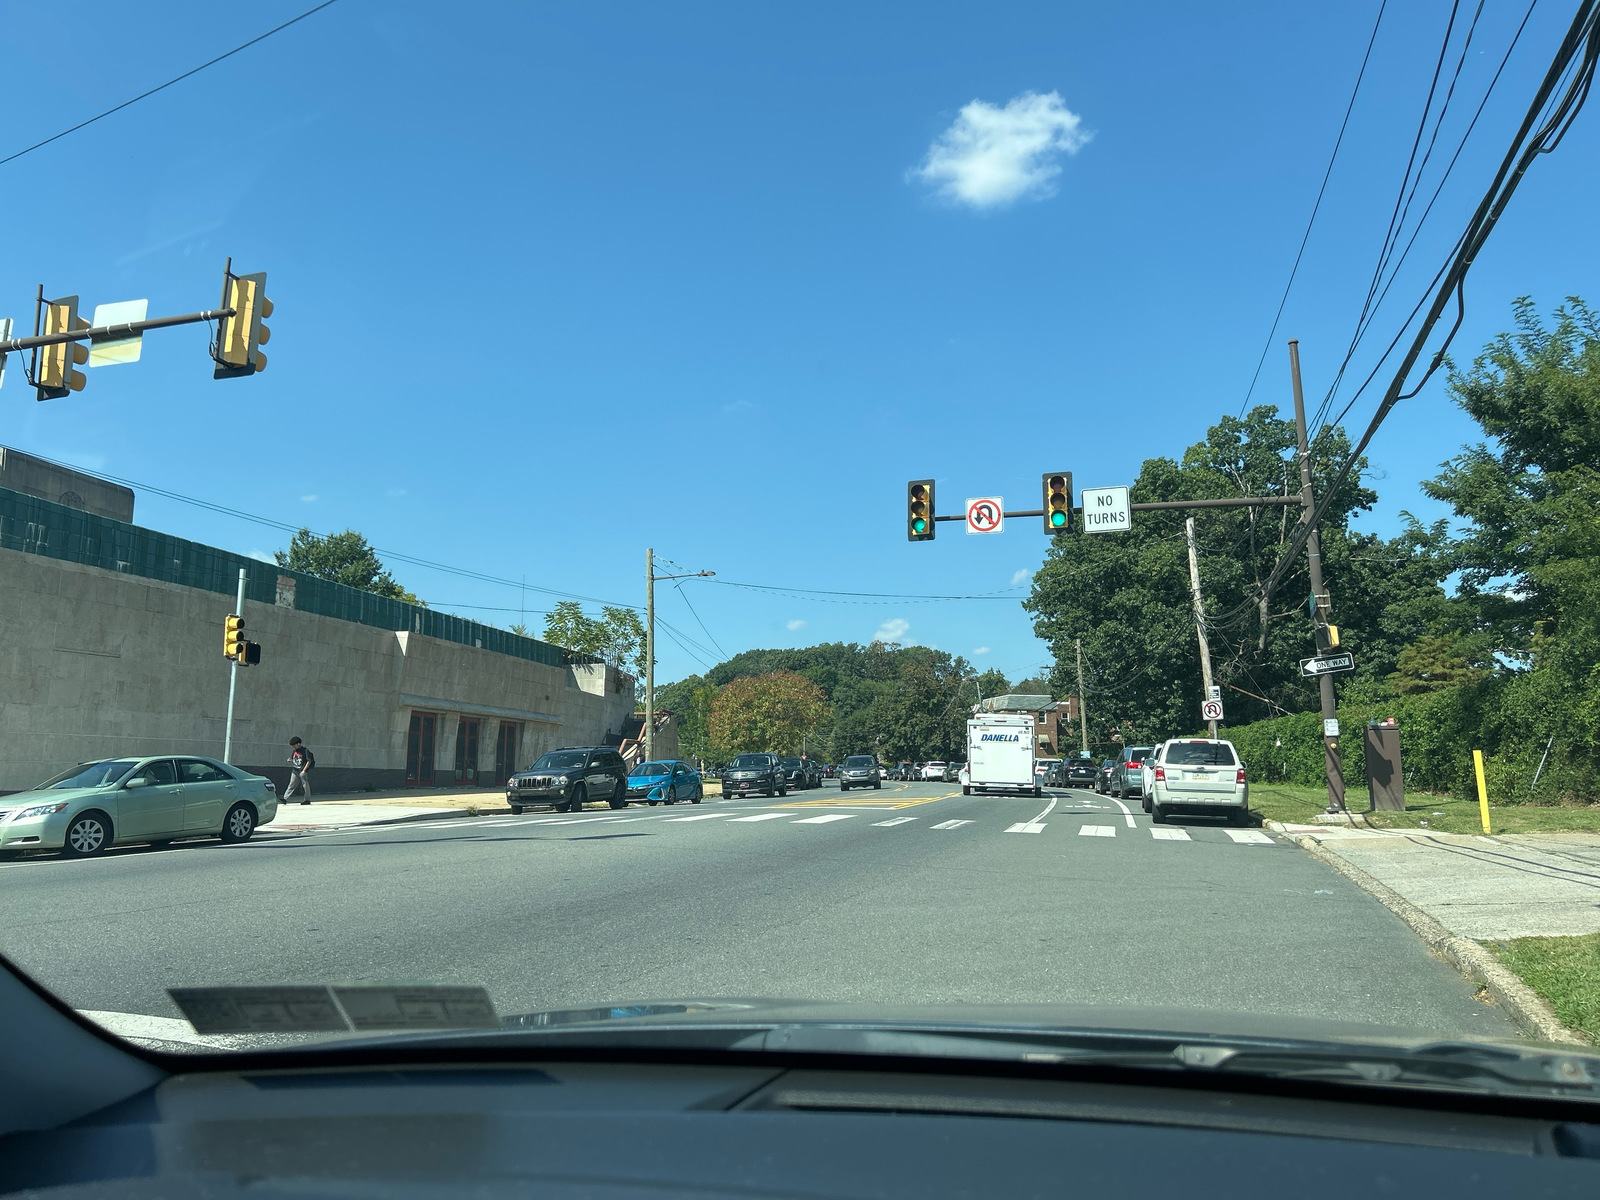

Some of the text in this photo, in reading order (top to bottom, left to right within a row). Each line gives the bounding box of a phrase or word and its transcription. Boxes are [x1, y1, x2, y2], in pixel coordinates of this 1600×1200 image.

[1097, 495, 1113, 507] NO
[1087, 511, 1125, 525] TURNS
[1316, 658, 1347, 669] ONE WAY
[981, 733, 1019, 742] DANELLA
